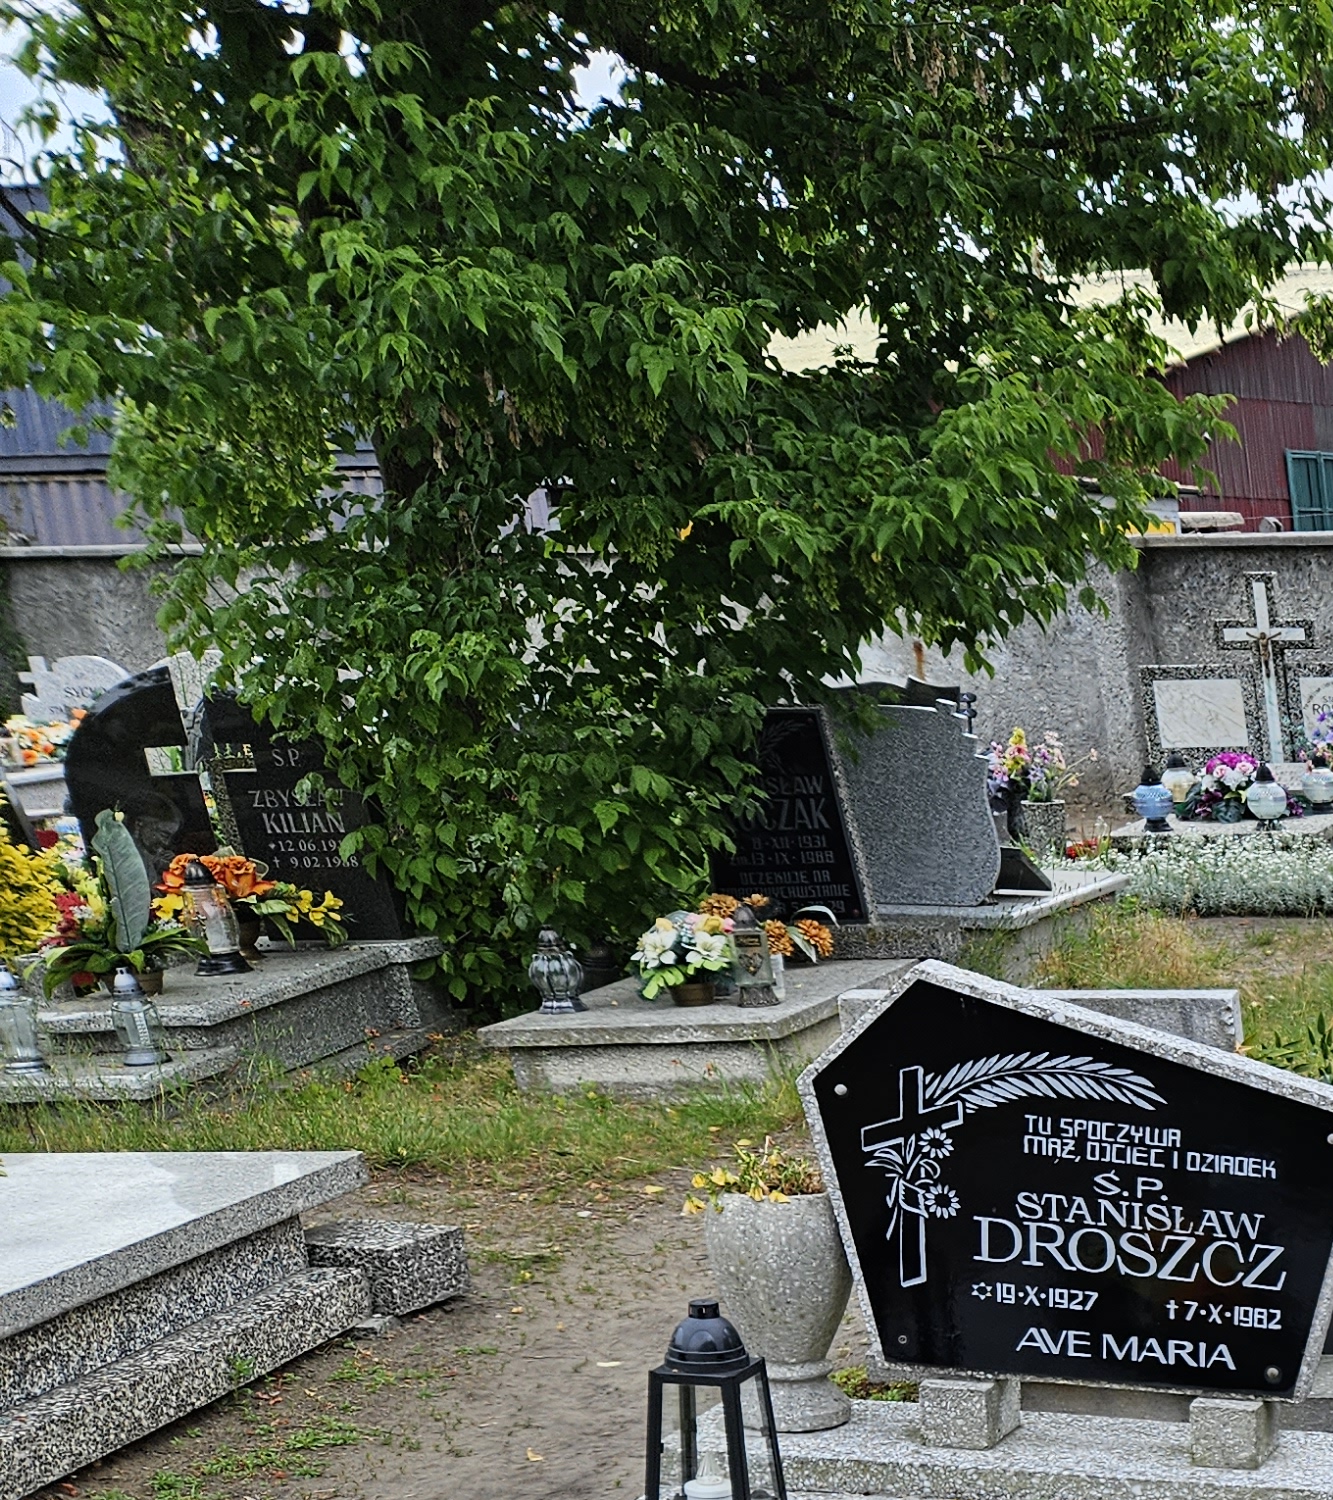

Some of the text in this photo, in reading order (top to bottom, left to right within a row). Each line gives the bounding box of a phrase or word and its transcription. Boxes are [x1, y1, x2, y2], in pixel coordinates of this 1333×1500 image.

[762, 775, 824, 796] SŁAW
[262, 812, 346, 834] KILIAN
[1024, 1114, 1182, 1148] TU SPOCZYWA
[1086, 1141, 1166, 1168] OJCIEC
[1172, 1150, 1179, 1169] I
[1186, 1151, 1278, 1180] DZIADEK
[1015, 1190, 1266, 1240] STANISŁAW
[972, 1215, 1288, 1292] DROSZCZ
[1015, 1326, 1238, 1371] AVE MARIA
